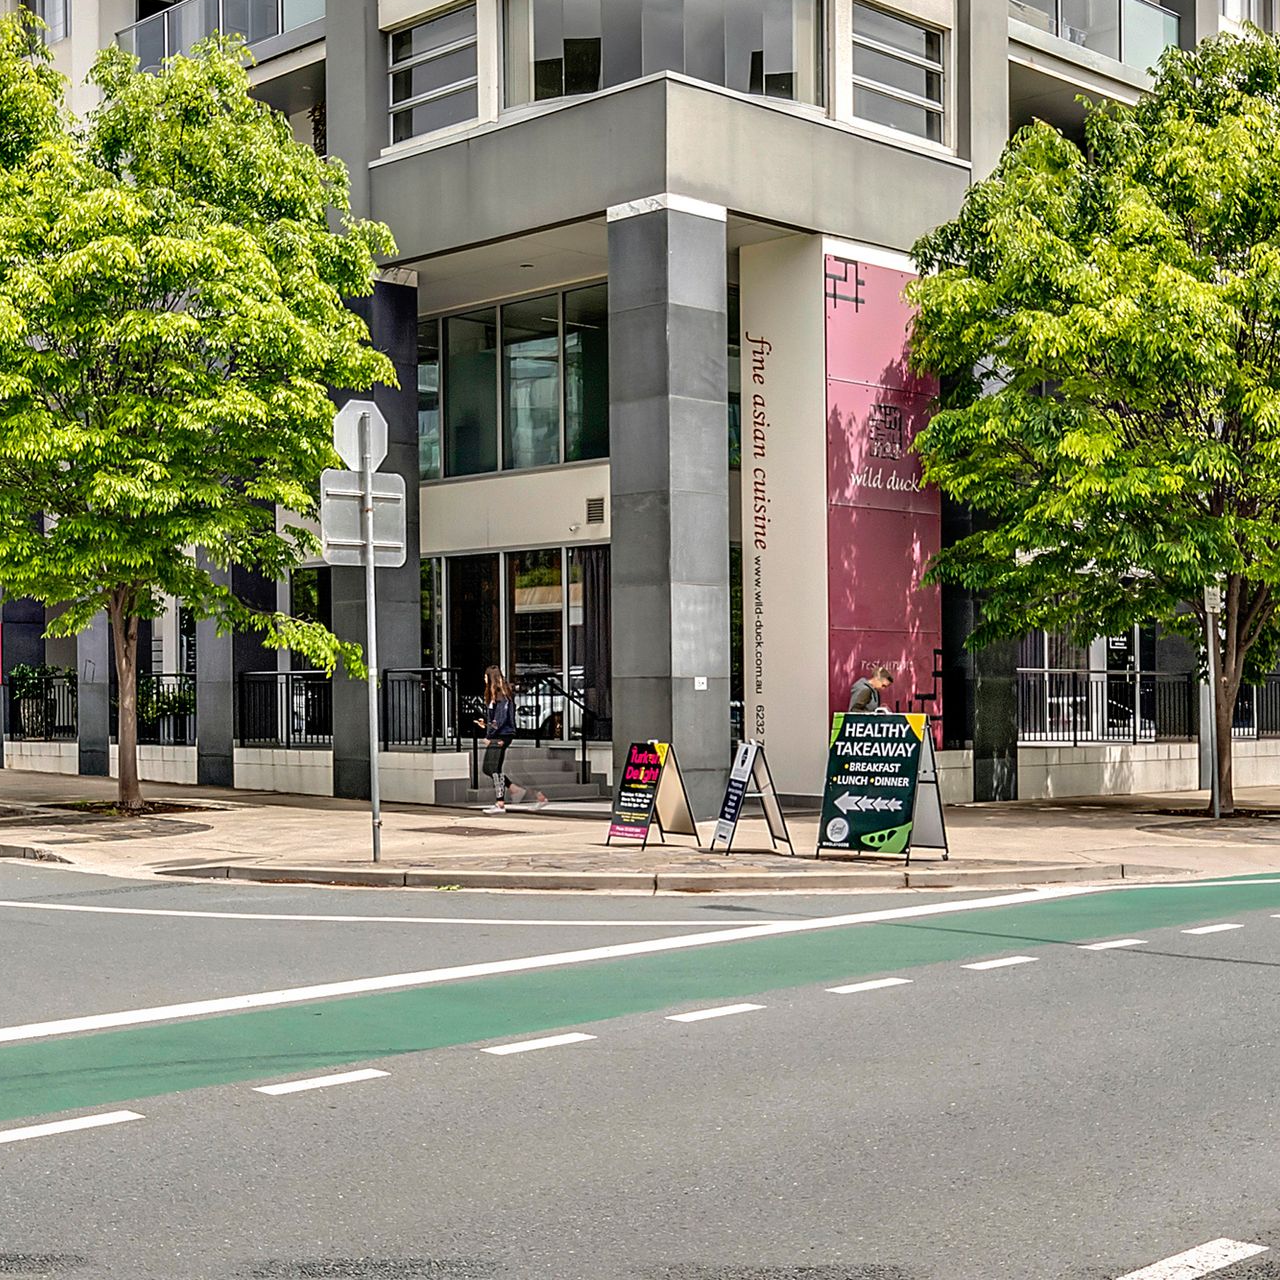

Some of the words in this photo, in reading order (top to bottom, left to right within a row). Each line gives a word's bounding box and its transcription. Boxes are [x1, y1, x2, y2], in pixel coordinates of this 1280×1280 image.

[745, 331, 772, 385] fine
[753, 393, 770, 458] asian
[850, 467, 882, 489] wild
[886, 470, 920, 492] duck
[754, 467, 771, 549] cuisine
[754, 555, 764, 695] www.wild-duck.com.au
[755, 704, 765, 735] 6232
[845, 723, 911, 738] HEALTHY
[835, 741, 917, 757] TAKEAWAY
[625, 766, 660, 783] Delight
[849, 762, 901, 773] BREAKFAST
[837, 776, 869, 785] LUNCH
[874, 776, 910, 787] DINNER
